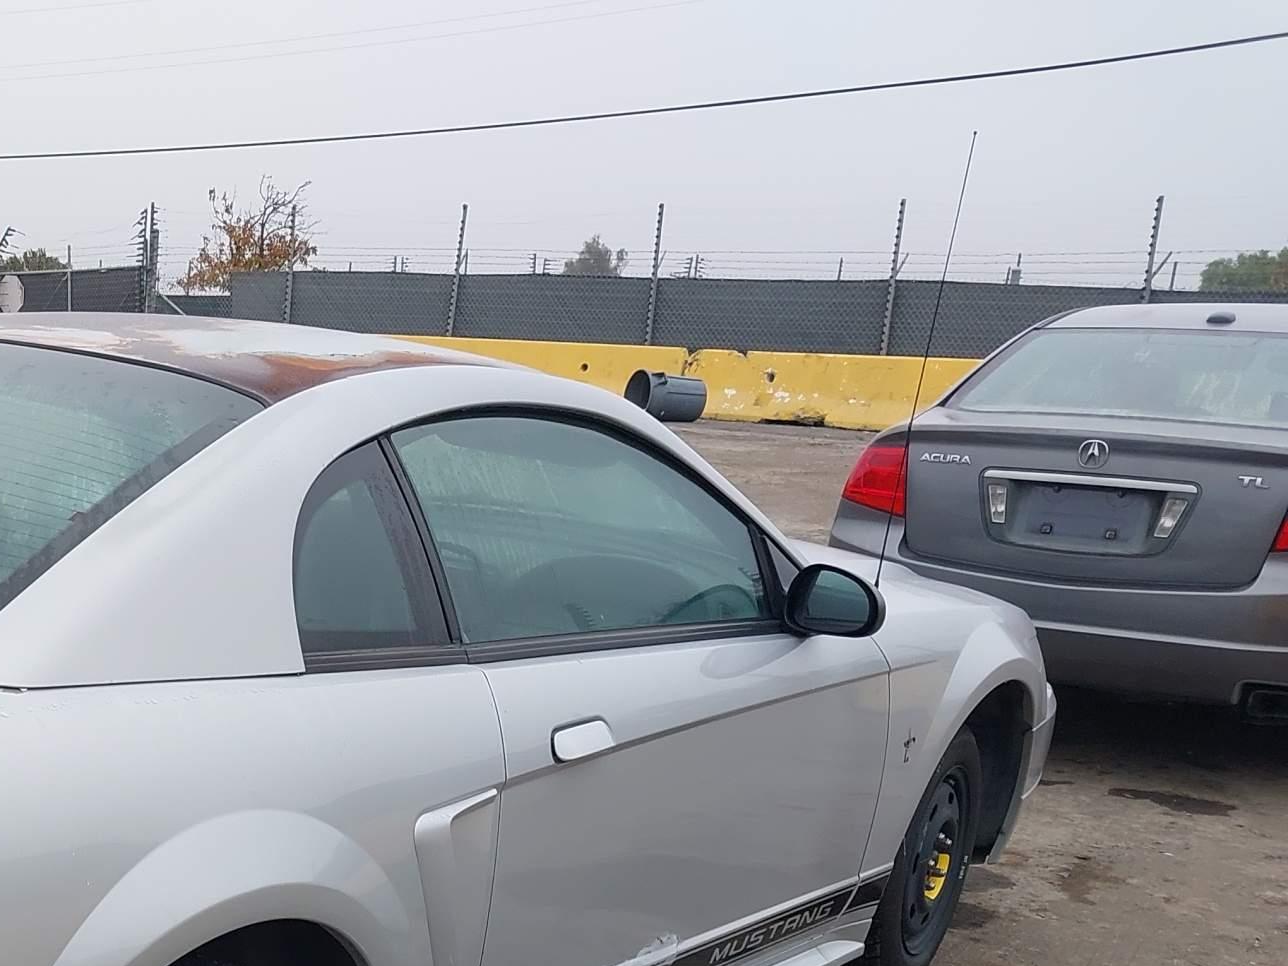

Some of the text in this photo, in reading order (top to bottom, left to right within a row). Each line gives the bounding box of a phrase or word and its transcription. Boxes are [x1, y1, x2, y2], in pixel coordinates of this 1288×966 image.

[920, 452, 971, 465] ACURA
[1238, 475, 1270, 488] TL
[709, 900, 834, 964] MUSTANG
